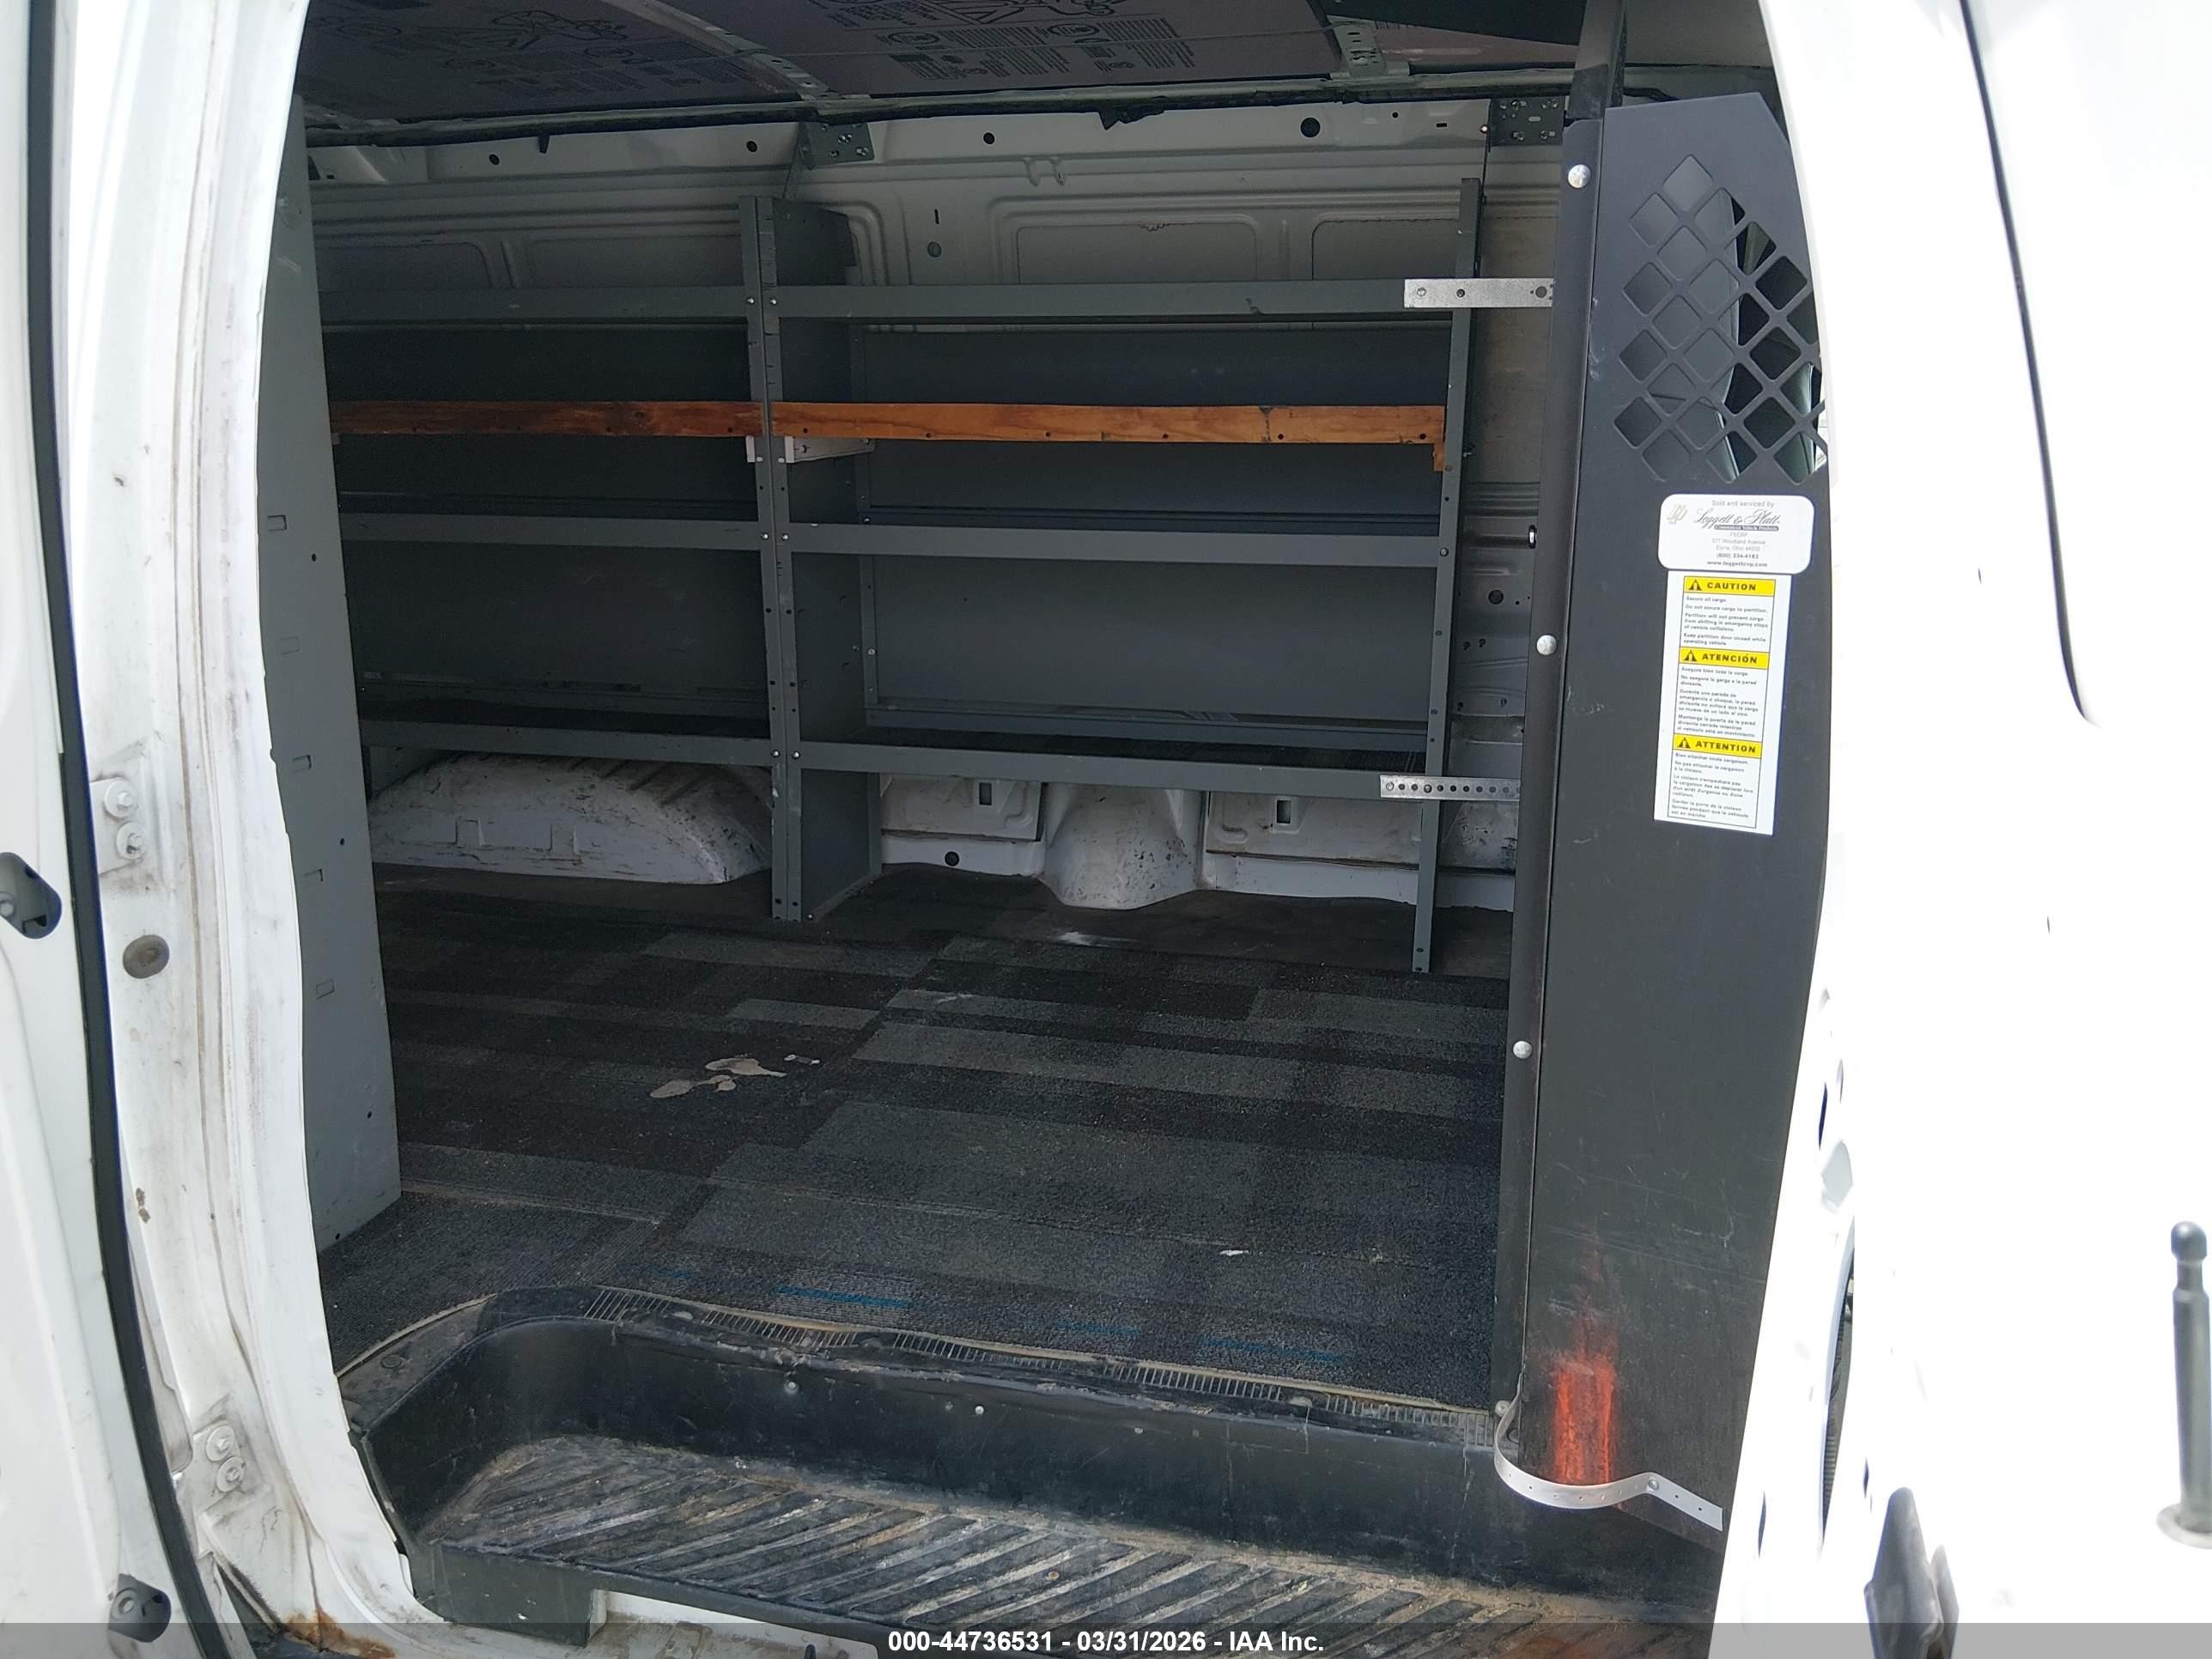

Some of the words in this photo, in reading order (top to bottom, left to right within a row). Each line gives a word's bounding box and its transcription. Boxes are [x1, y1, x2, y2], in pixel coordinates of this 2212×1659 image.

[1694, 508, 1735, 529] Leggett
[1707, 582, 1755, 591] CAUTION
[1702, 653, 1757, 663] ATENCIÓN
[1695, 740, 1755, 752] ATTENTION
